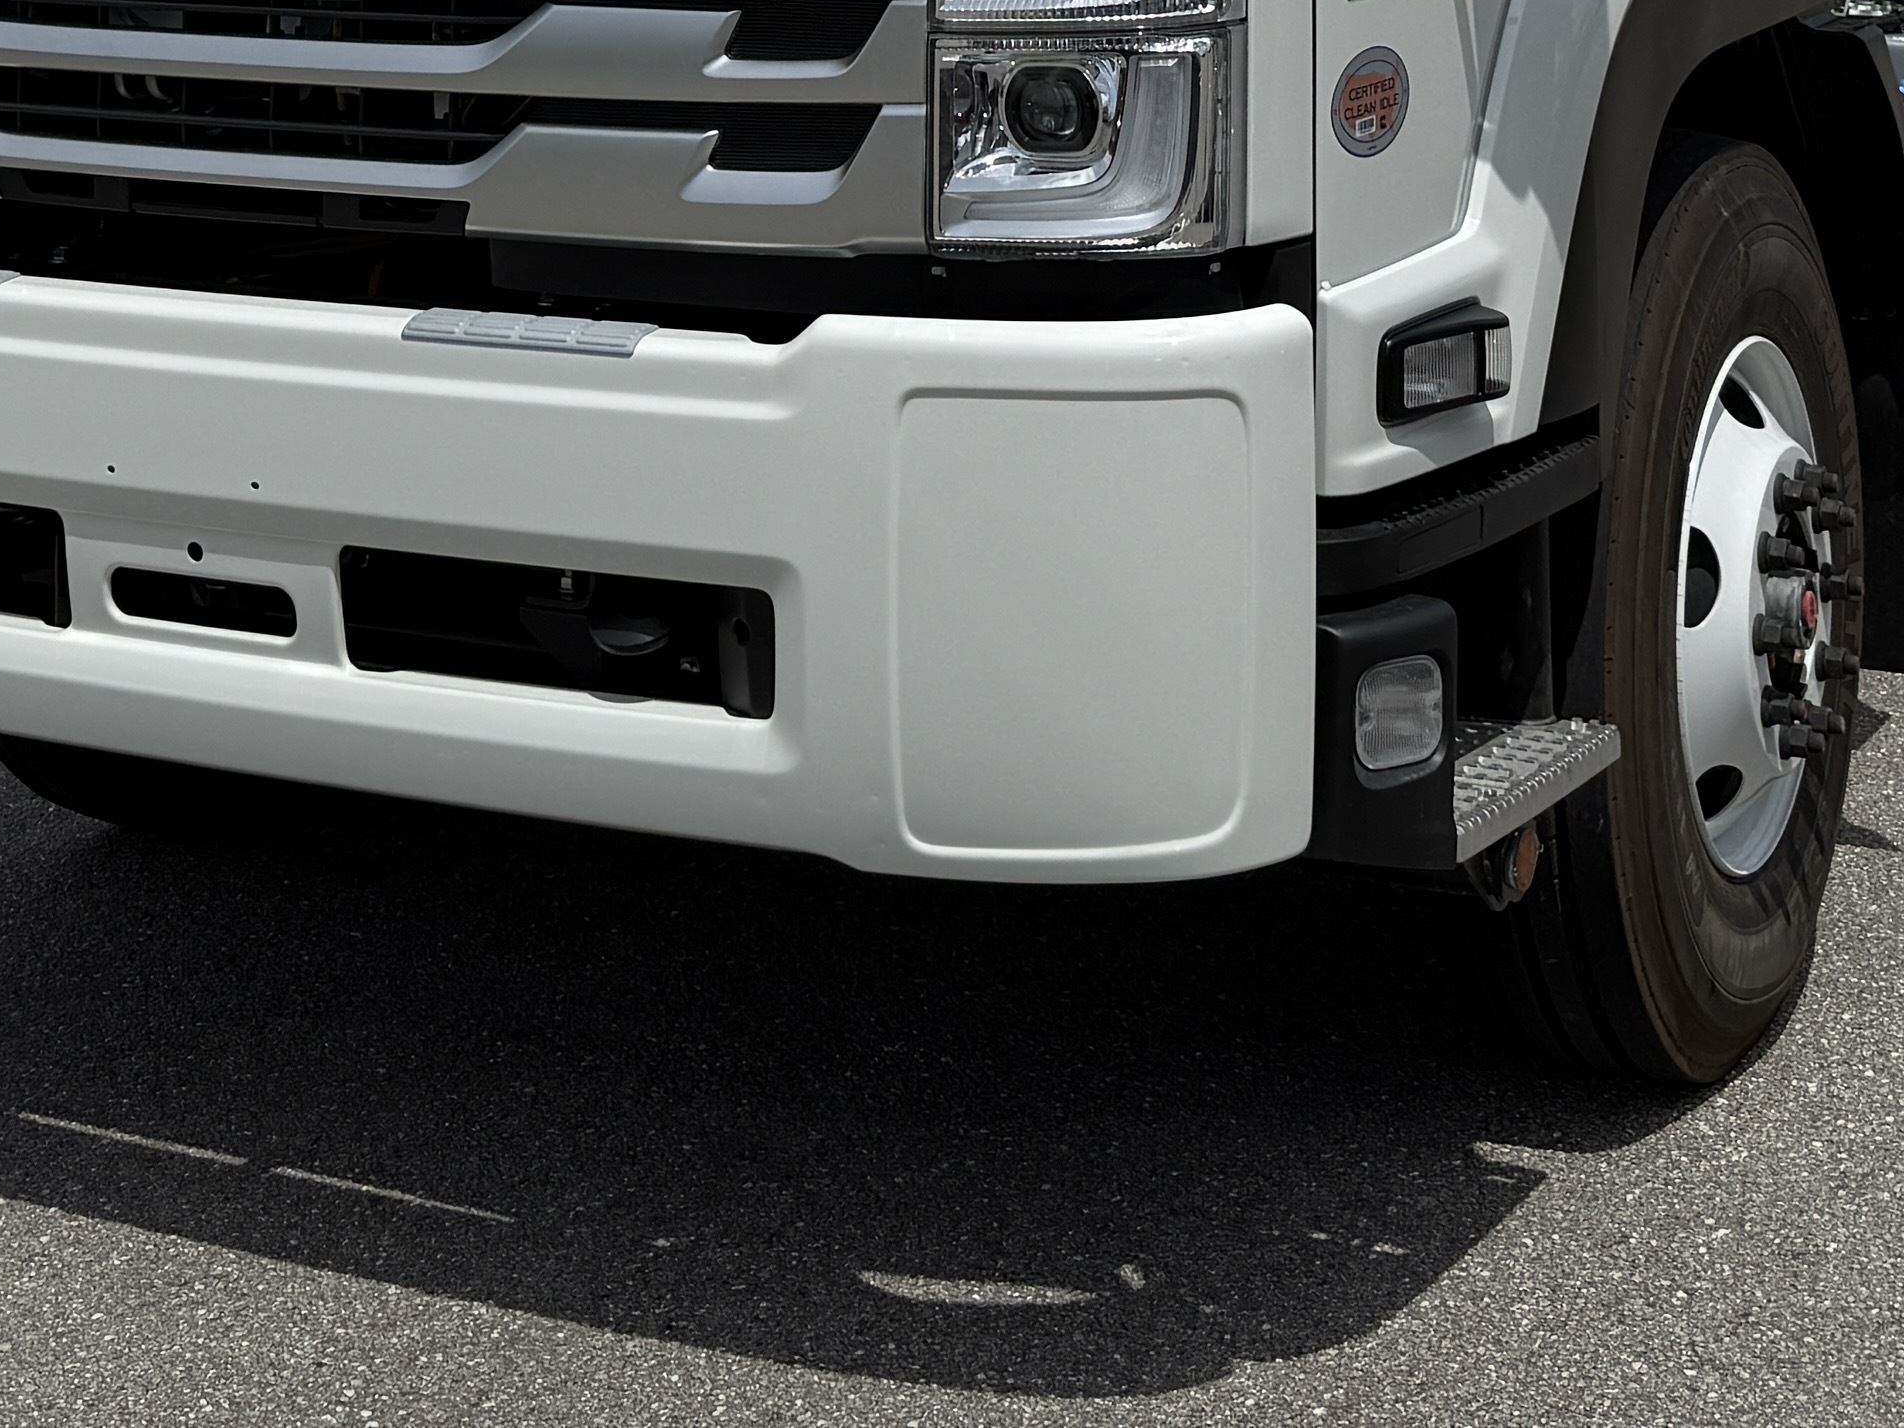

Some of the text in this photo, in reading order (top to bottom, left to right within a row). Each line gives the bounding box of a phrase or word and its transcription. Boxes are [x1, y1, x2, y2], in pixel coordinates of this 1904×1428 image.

[1348, 77, 1396, 102] CERTIFIED
[1343, 92, 1400, 121] CLEAN IDLE
